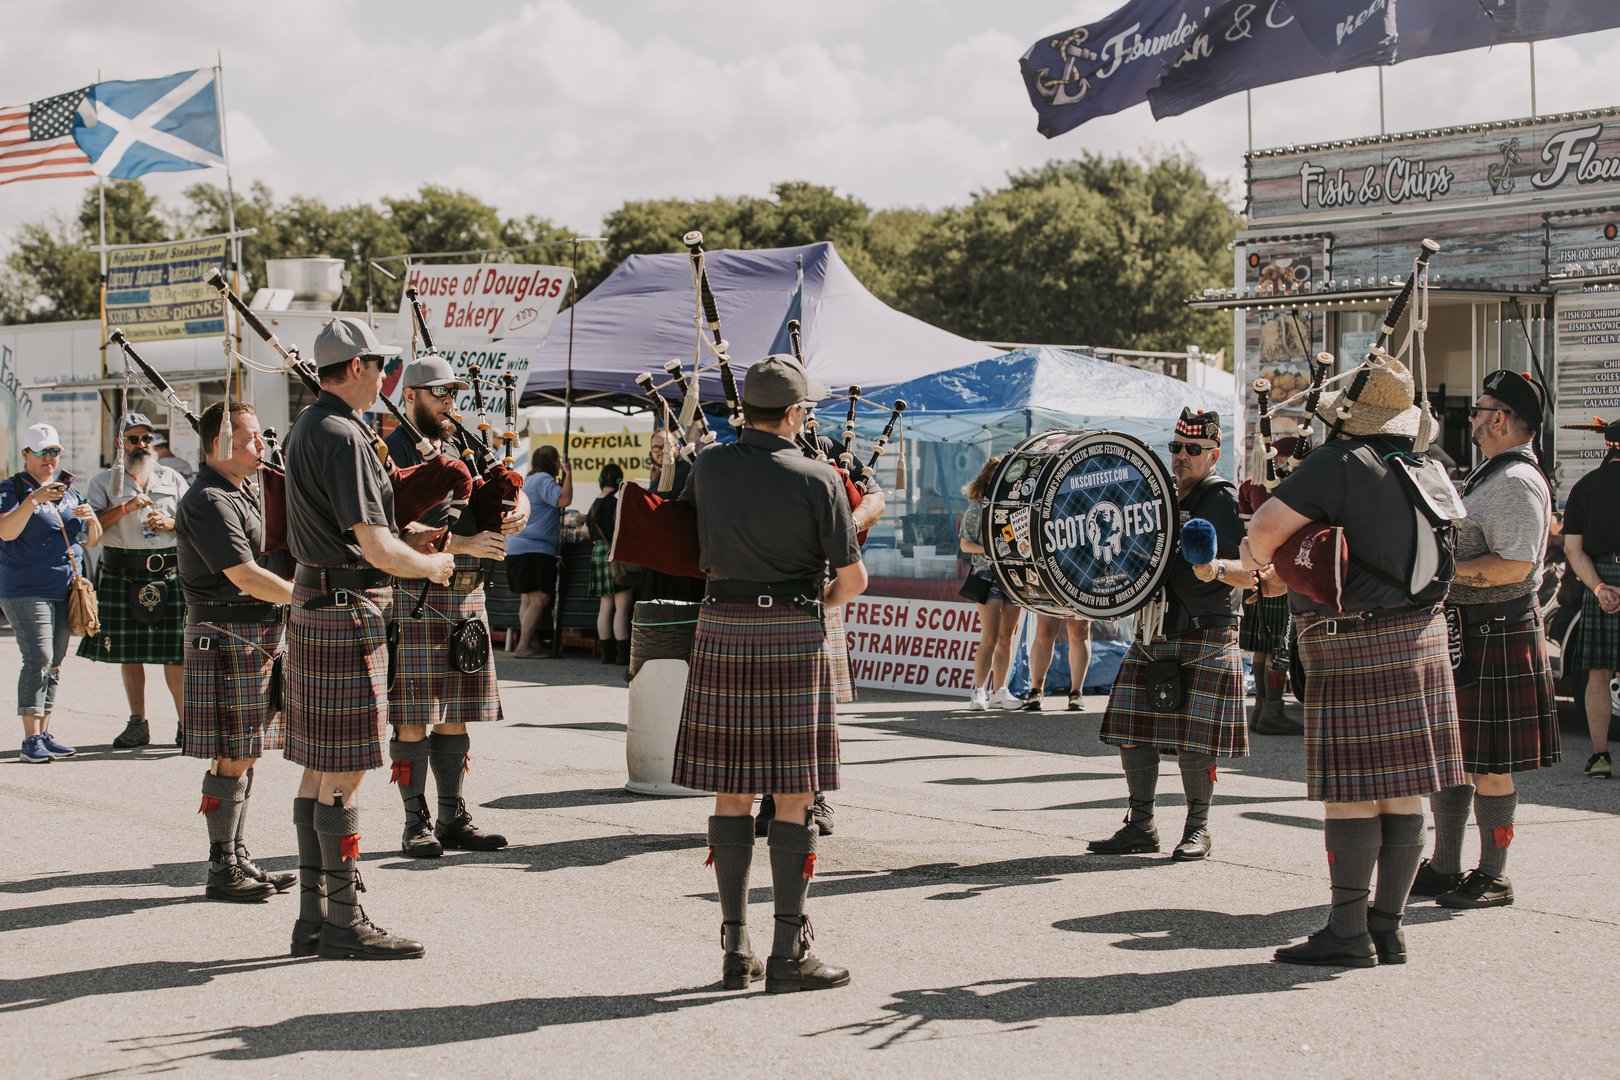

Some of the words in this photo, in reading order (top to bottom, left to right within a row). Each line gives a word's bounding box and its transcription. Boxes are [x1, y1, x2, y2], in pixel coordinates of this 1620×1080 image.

[1225, 4, 1256, 41] &
[1300, 162, 1354, 207] Fish
[1359, 166, 1381, 203] &
[1384, 157, 1453, 203] Chips
[149, 249, 168, 261] Beef
[1560, 251, 1576, 262] FISH
[1578, 249, 1590, 261] OR
[1591, 247, 1620, 259] SHRIMP
[408, 271, 459, 296] House
[463, 268, 482, 295] of
[483, 269, 563, 302] Douglas
[173, 300, 223, 320] DRINKS
[444, 301, 505, 334] Bakery
[1564, 312, 1579, 320] FISH
[1581, 311, 1592, 319] OR
[1593, 309, 1620, 318] SHRIMP
[1568, 323, 1584, 331] FISH
[1581, 335, 1615, 344] CHICKEN
[457, 352, 507, 370] SCONE
[507, 358, 529, 370] with
[1582, 387, 1606, 395] KRAUT
[571, 435, 641, 448] OFFICIAL
[1043, 481, 1060, 519] OKLAHOMA'S
[1057, 460, 1076, 482] PREMIER
[1072, 449, 1089, 465] CELTIC
[1088, 445, 1104, 457] MUSIC
[1104, 444, 1126, 459] FESTIVAL
[1126, 451, 1131, 460] &
[1130, 453, 1151, 479] HIGHLAND
[1147, 476, 1161, 497] GAMES
[1070, 468, 1129, 490] OKSCOTFEST.COM
[1044, 514, 1087, 553] SCOT
[1124, 498, 1163, 537] FEST
[1047, 556, 1067, 586] CHISHOLM
[1065, 581, 1078, 599] TRAIL
[1078, 591, 1096, 606] SOUTH
[1096, 595, 1110, 606] PARK
[1115, 588, 1136, 604] BROKEN
[1135, 571, 1151, 591] ARROW
[1150, 532, 1165, 569] OKLAHOMA
[844, 602, 909, 628] FRESH
